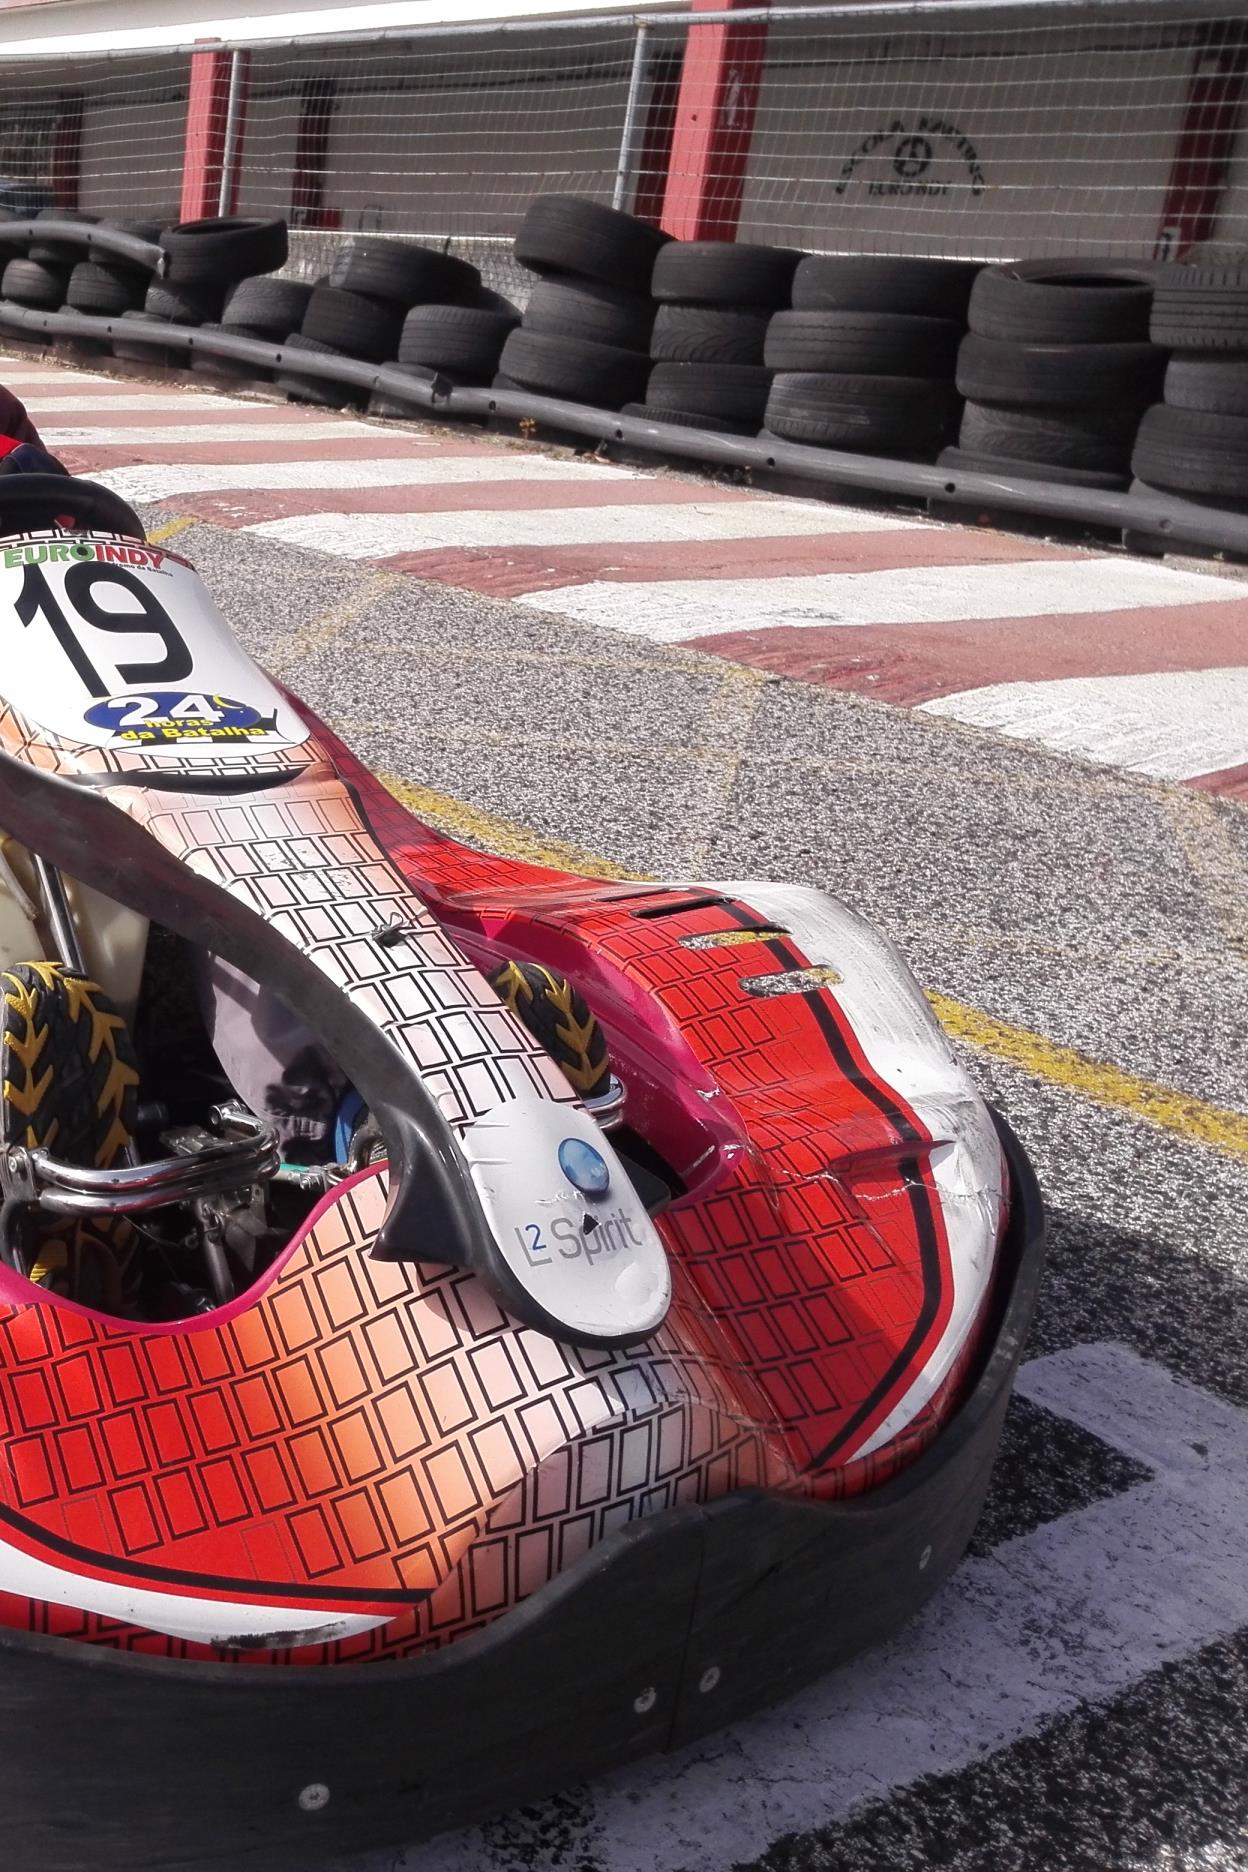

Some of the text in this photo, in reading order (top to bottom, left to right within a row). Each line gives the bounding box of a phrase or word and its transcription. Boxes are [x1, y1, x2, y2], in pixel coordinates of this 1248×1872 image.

[3, 543, 167, 570] EUROINDY
[13, 560, 194, 698] 19
[107, 694, 226, 727] 24
[143, 717, 214, 729] horas
[120, 725, 266, 742] da Batalha
